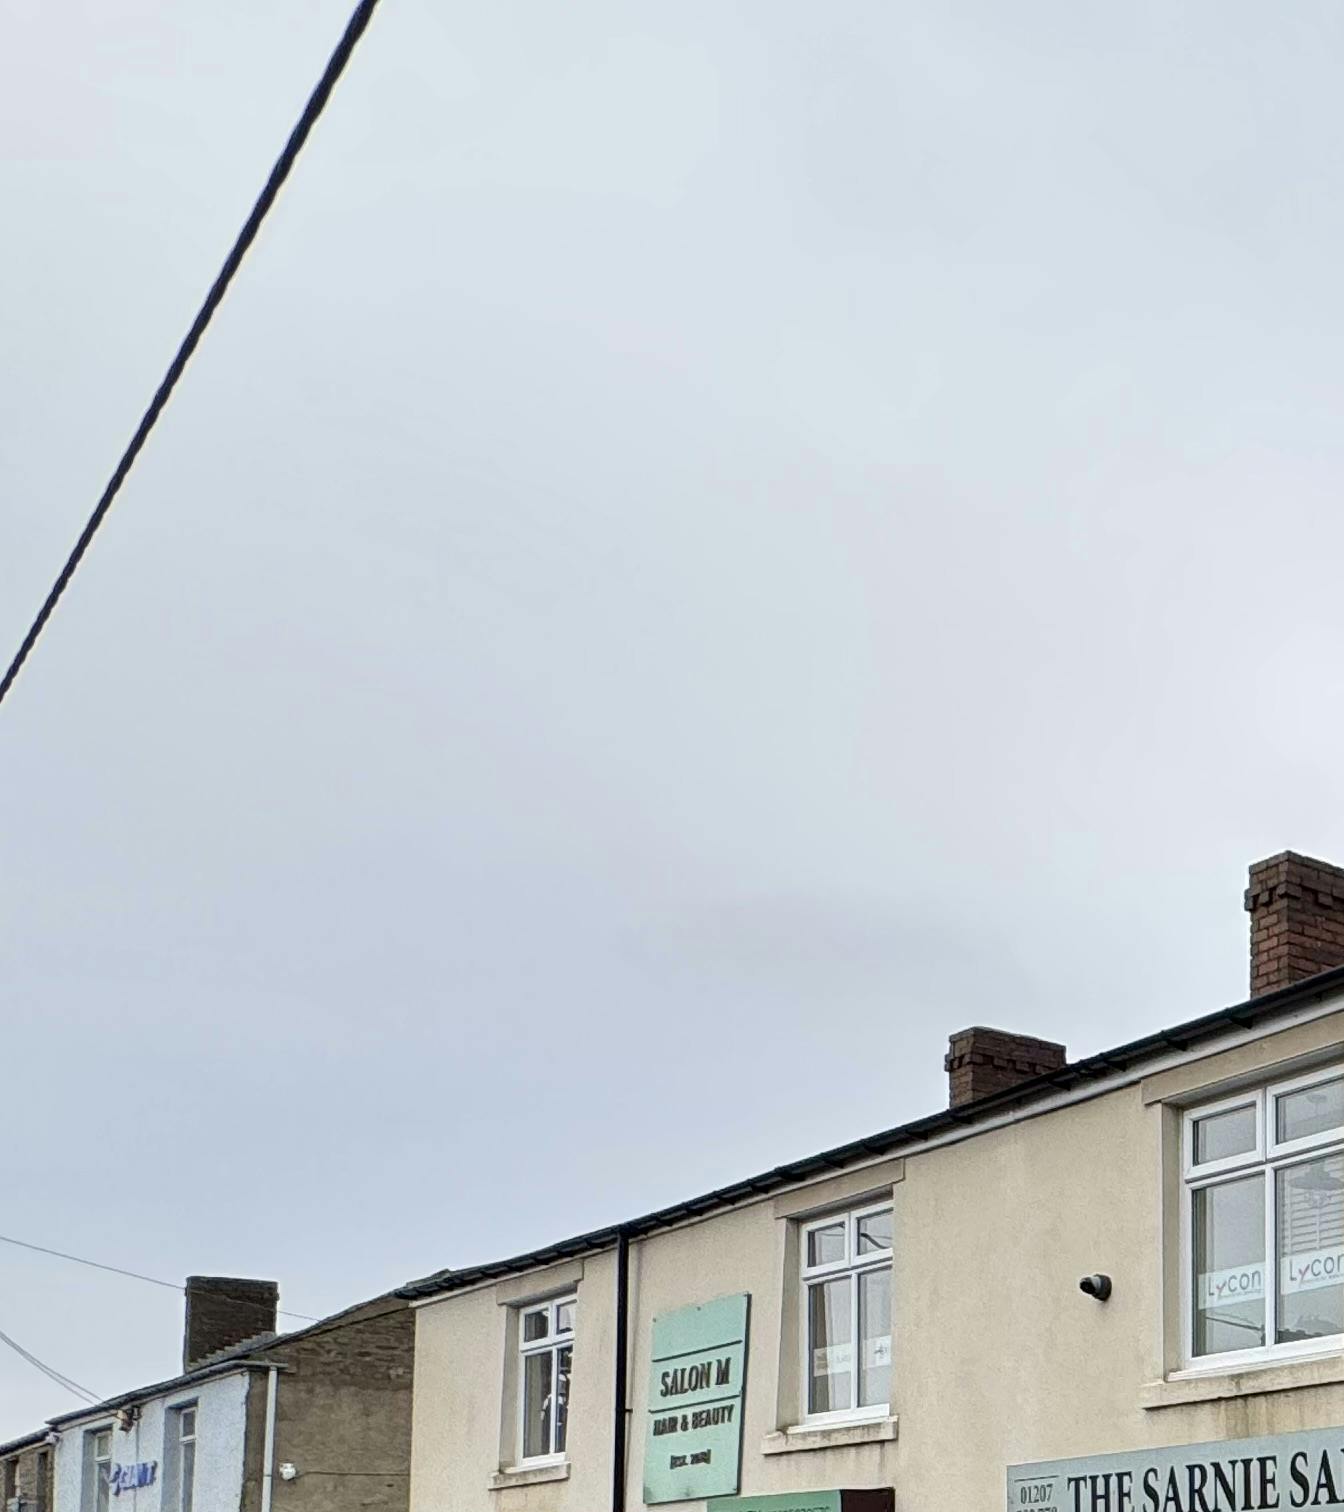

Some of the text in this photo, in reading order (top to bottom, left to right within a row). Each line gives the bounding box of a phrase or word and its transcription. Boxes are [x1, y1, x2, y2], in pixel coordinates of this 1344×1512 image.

[660, 1356, 732, 1398] SALON M
[653, 1404, 735, 1437] HAIR & BEAUTY
[1020, 1483, 1053, 1505] 01207
